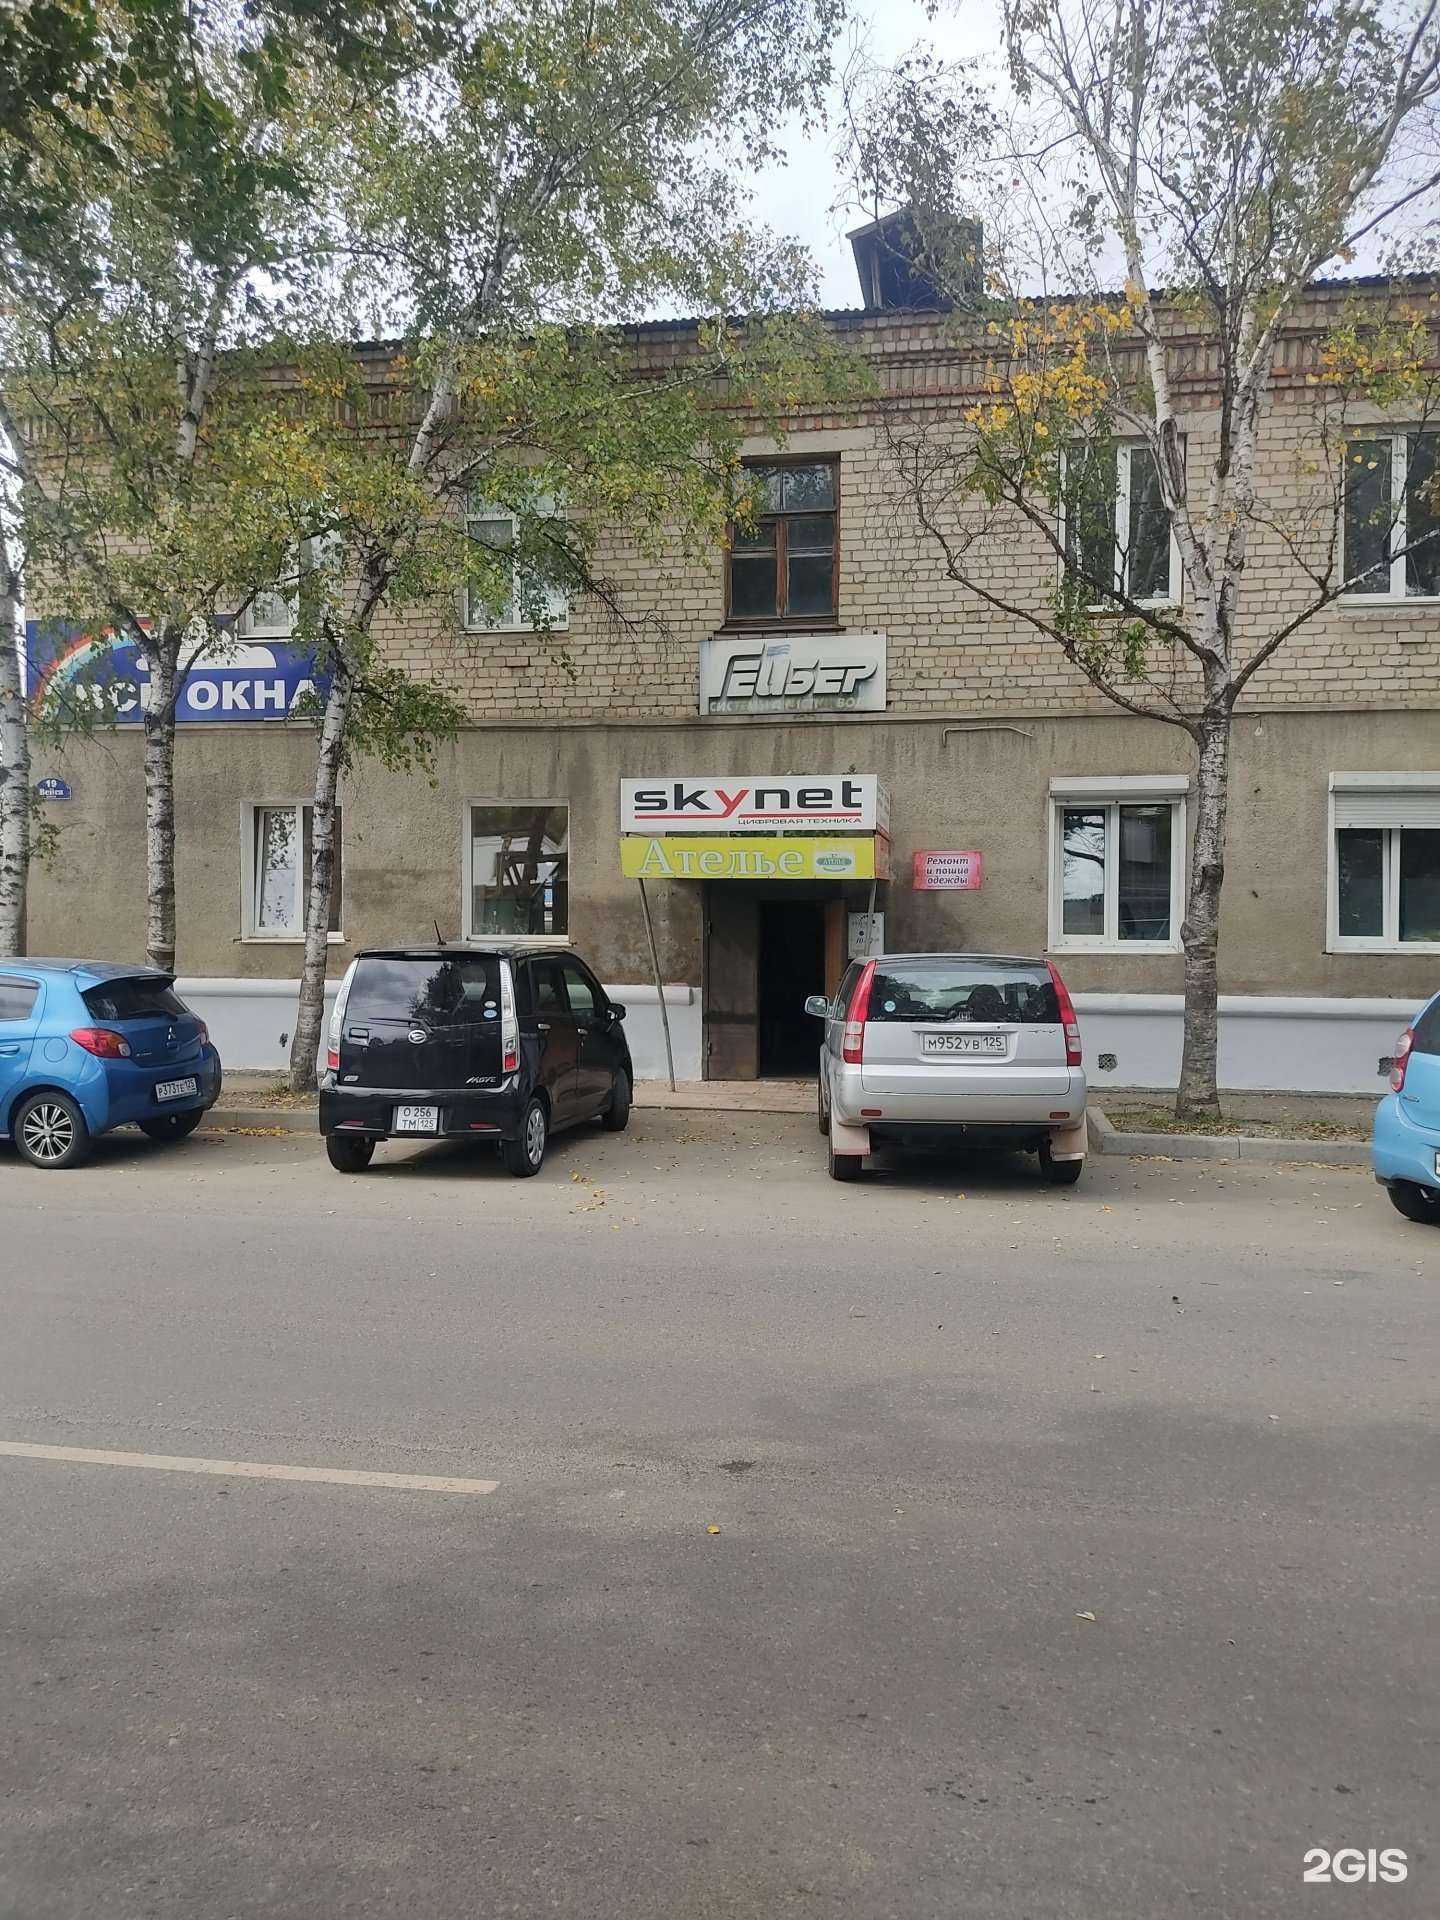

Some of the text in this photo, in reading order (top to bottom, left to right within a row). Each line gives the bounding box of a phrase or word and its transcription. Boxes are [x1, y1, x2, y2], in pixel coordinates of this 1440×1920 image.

[634, 781, 862, 817] skynet
[738, 816, 862, 826] ЦИФРОВАЯ ТЕХНИКА
[638, 839, 804, 876] Ателье
[926, 856, 969, 865] Ремонт
[927, 876, 968, 885] одежды
[413, 1107, 432, 1118] 256
[420, 1119, 434, 1129] 125
